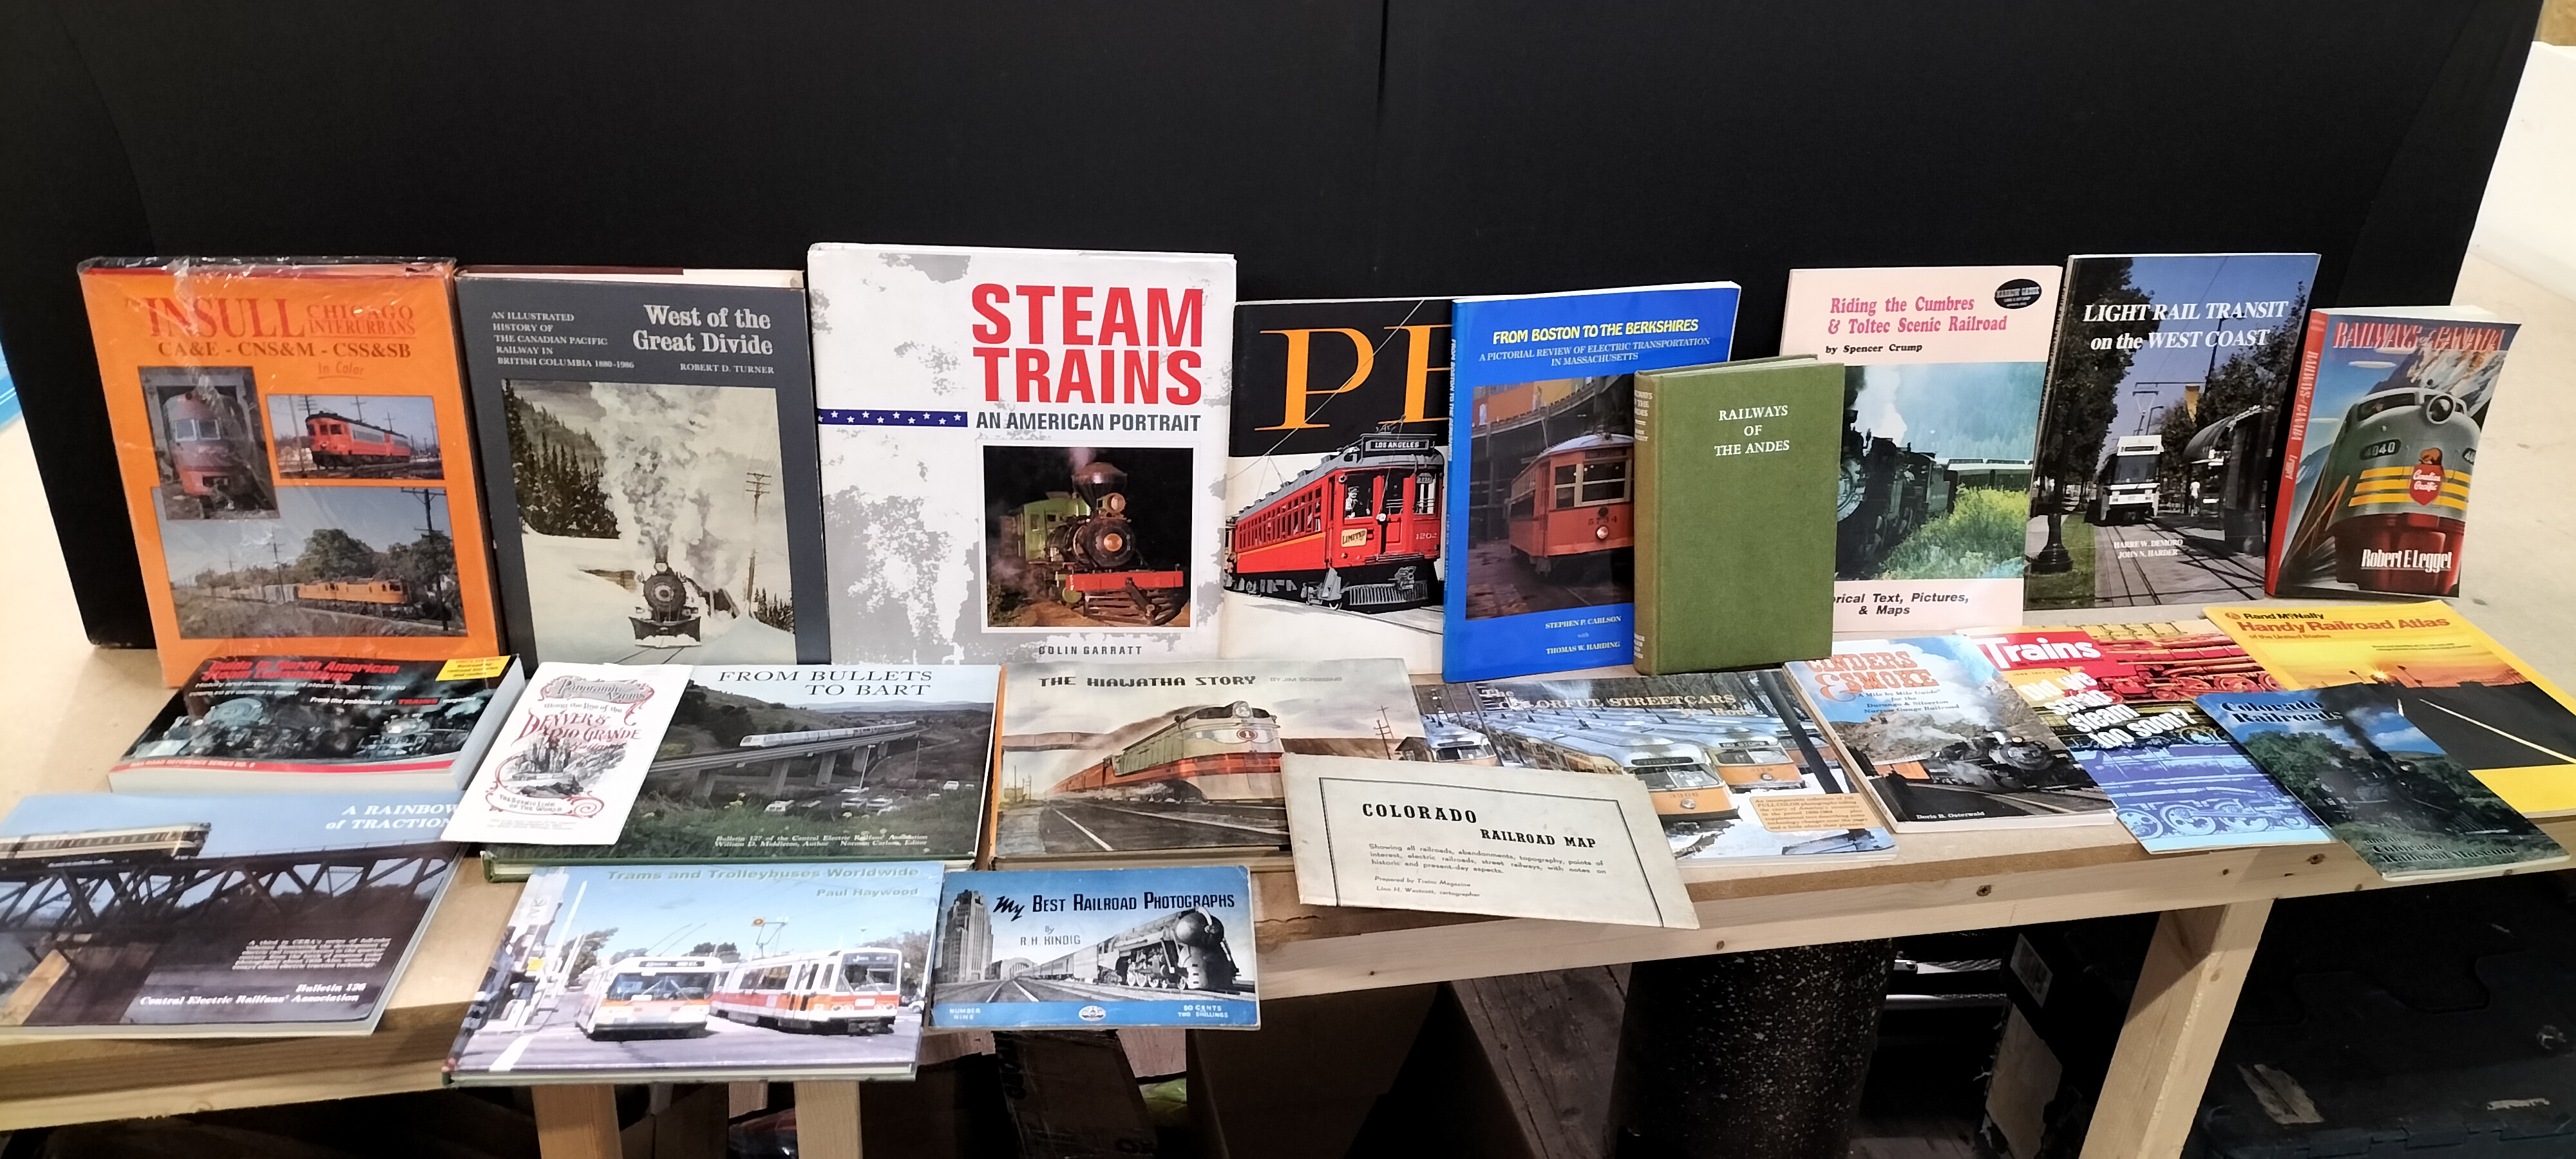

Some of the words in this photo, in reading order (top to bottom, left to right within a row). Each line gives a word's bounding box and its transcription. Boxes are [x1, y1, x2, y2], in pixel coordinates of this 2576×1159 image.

[306, 304, 413, 320] CHICAGO
[1830, 298, 1877, 316] Riding
[1885, 297, 1907, 312] the
[1915, 296, 1974, 311] Cumbres
[2083, 304, 2150, 322] LIGHT
[2154, 304, 2201, 321] RAIL
[2205, 301, 2289, 319] TRANSIT
[143, 297, 305, 337] INSULL
[491, 312, 505, 320] AN
[507, 312, 574, 321] ILLUSTRATED
[644, 305, 701, 326] West
[706, 307, 729, 328] of
[734, 308, 771, 329] the
[972, 283, 1203, 347] STEAM
[493, 323, 537, 332] HISTORY
[540, 324, 553, 332] OF
[1493, 330, 1528, 344] FROM
[1531, 326, 1580, 342] BOSTON
[1583, 325, 1598, 338] TO
[1600, 323, 1623, 337] THE
[1625, 319, 1699, 335] BERKSHIRES
[1828, 321, 1839, 334] &
[1849, 318, 1890, 334] Toltec
[1898, 317, 1940, 332] Scenic
[1949, 316, 2007, 331] Railroad
[518, 335, 567, 344] CANADIAN
[569, 336, 608, 345] PACIFIC
[2090, 337, 2112, 350] on
[2116, 333, 2143, 349] the
[2148, 332, 2203, 348] WEST
[2205, 329, 2271, 346] COAST
[2333, 321, 2423, 349] RAILWAYS
[632, 330, 695, 352] Great
[701, 332, 773, 355] Divide
[1479, 353, 1486, 362] A
[1487, 350, 1535, 361] PICTORIAL
[1537, 346, 1571, 357] REVIEW
[1573, 345, 1586, 355] OF
[1587, 342, 1631, 353] ELECTRIC
[1633, 337, 1710, 352] TRANSPORTATION
[1825, 345, 1837, 354] by
[1843, 344, 1883, 353] Spencer
[1889, 344, 1922, 353] Crump
[158, 343, 220, 356] CA&E
[238, 343, 315, 356] CNS&M
[333, 343, 411, 358] CSS&SB
[496, 346, 539, 354] RAILWAY
[498, 357, 536, 366] BRITISH
[538, 358, 592, 367] COLUMBIA
[1551, 358, 1562, 366] IN
[1563, 352, 1639, 366] MASSACHUSETTS
[680, 363, 719, 372] ROBERT
[734, 365, 775, 374] TURNER
[973, 347, 1202, 405] TRAINS
[1719, 406, 1788, 420] RAILWAYS
[976, 412, 1001, 429] AN
[1007, 413, 1105, 431] AMERICAN
[1110, 414, 1201, 431] PORTRAIT
[1744, 425, 1762, 436] OF
[1714, 444, 1741, 456] THE
[1745, 440, 1790, 455] ANDES
[1342, 531, 1366, 545] LIMITED
[2150, 538, 2183, 547] DEMORO
[2147, 549, 2178, 557] HARDER
[2362, 549, 2402, 567] Robert
[2413, 550, 2452, 573] Legget
[1873, 594, 1903, 604] Text,
[1911, 592, 1969, 603] Pictures,
[1859, 606, 1868, 615] &
[1877, 605, 1910, 616] Maps
[1545, 619, 1578, 629] STEPHEN
[1587, 616, 1622, 626] CARLSON
[2237, 621, 2306, 633] Handy
[2311, 618, 2395, 632] Railroad
[2398, 616, 2451, 629] Atlas
[1083, 646, 1142, 655] GARRATT
[1546, 645, 1577, 655] THOMAS
[1586, 641, 1620, 651] HARDING
[1971, 637, 2101, 669] Trains
[323, 661, 399, 674] American
[1805, 651, 1918, 672] CINDERS
[719, 671, 800, 682] FROM
[809, 670, 933, 681] BULLETS
[1038, 677, 1077, 688] THE
[1086, 677, 1186, 687] HIAWATHA
[1195, 675, 1256, 686] STORY
[1839, 669, 1940, 692] SMOKE
[805, 684, 845, 696] TO
[855, 684, 931, 696] BART
[2018, 681, 2054, 702] Did
[2059, 672, 2098, 690] we
[1609, 694, 1736, 707] STREETCARS
[2045, 690, 2113, 716] scrap
[2221, 700, 2324, 711] Colorado
[2067, 702, 2141, 733] steam
[2232, 710, 2344, 723] Railroads
[583, 726, 642, 740] GRANDE
[1244, 731, 1252, 739] 1
[2089, 729, 2126, 750] too
[2130, 708, 2199, 739] soon?
[341, 805, 356, 815] A
[1362, 804, 1477, 824] COLORADO
[325, 819, 346, 829] of
[1481, 829, 1556, 846] RAILROAD
[1565, 836, 1596, 849] MAP
[607, 871, 662, 881] Trams
[668, 871, 703, 880] and
[708, 869, 820, 880] Trolleybuses
[827, 867, 919, 878] Worldwide
[852, 888, 918, 897] Haywood
[992, 896, 1025, 921] My
[1032, 894, 1065, 913] BEST
[1073, 894, 1137, 912] RAILROAD
[1143, 892, 1235, 909] PHOTOGRAPHS
[1045, 925, 1054, 934] By
[1044, 935, 1081, 945] KINDIG
[140, 996, 185, 1006] Central
[187, 995, 233, 1005] Electric
